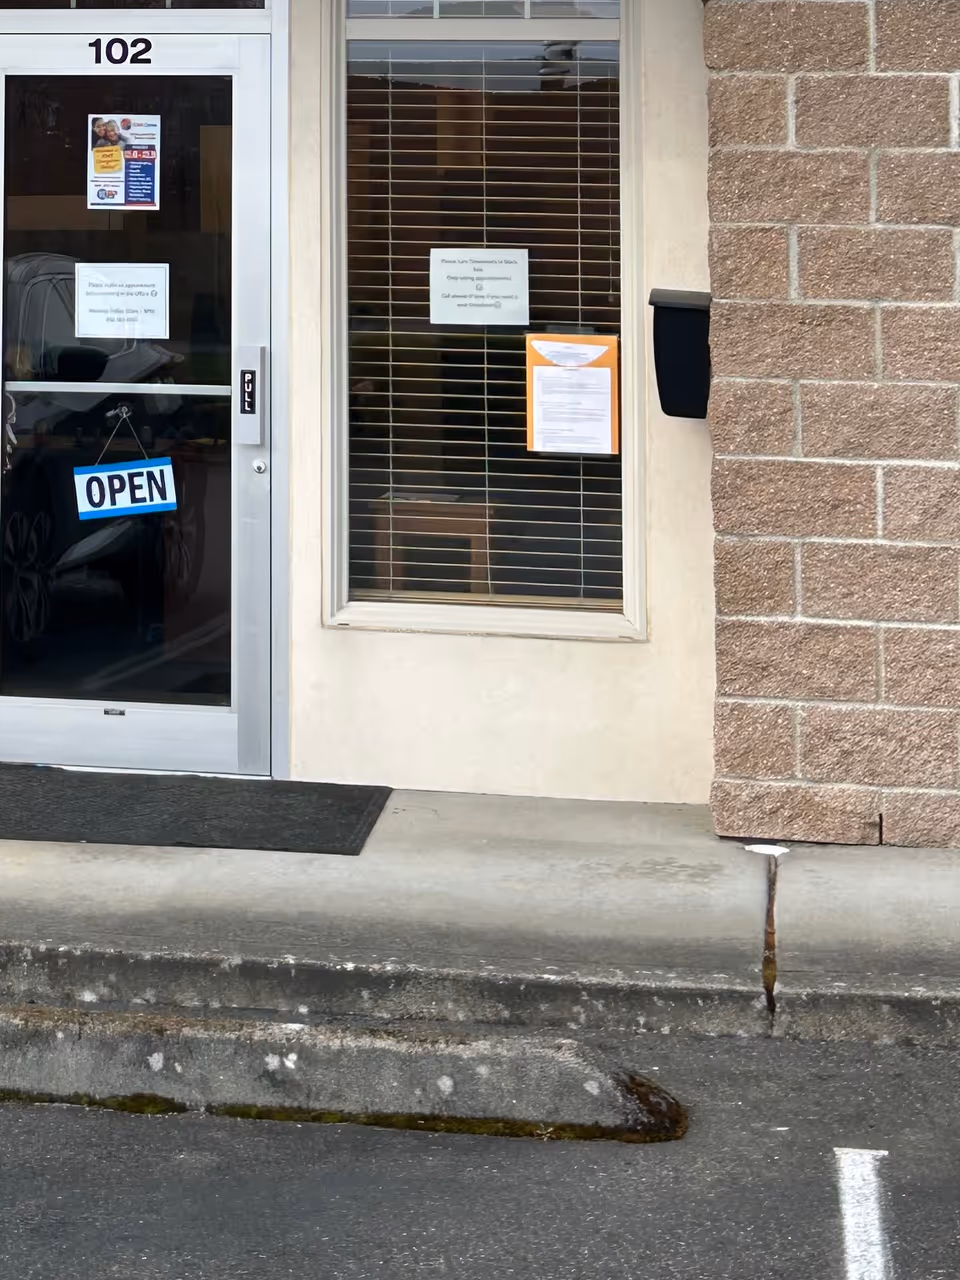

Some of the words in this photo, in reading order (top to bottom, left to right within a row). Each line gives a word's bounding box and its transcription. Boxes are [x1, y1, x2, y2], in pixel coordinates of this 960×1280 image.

[88, 37, 153, 65] 102
[244, 373, 253, 411] PULL
[85, 468, 168, 509] OPEN
